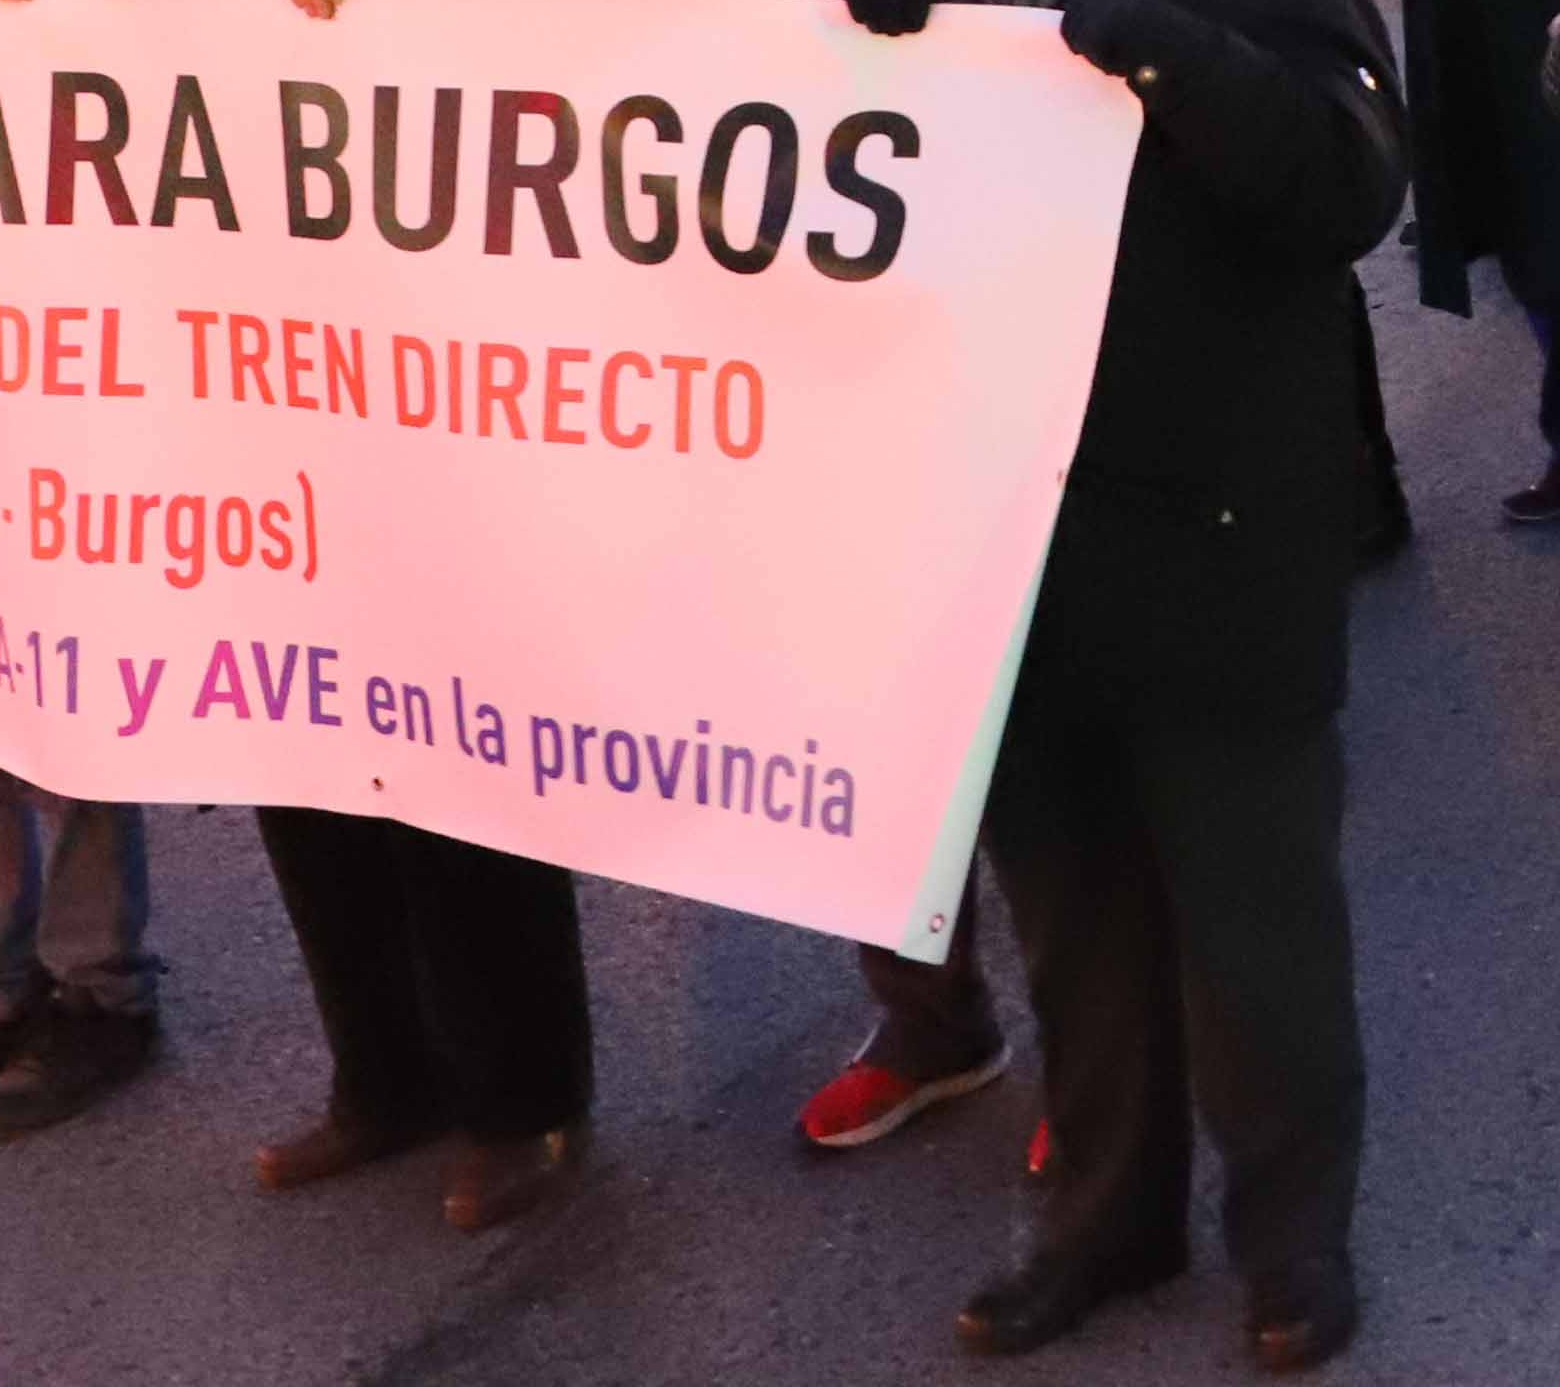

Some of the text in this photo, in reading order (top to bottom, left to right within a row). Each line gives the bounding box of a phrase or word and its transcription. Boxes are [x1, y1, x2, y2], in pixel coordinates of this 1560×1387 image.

[278, 79, 920, 283] BURGOS
[176, 309, 368, 419] TREN
[394, 333, 765, 461] DIRECTO
[29, 467, 318, 589] Burgos)
[117, 658, 166, 736] y
[192, 640, 342, 726] AVE
[366, 675, 434, 746] en
[452, 677, 506, 765] la
[531, 715, 856, 837] provincia
